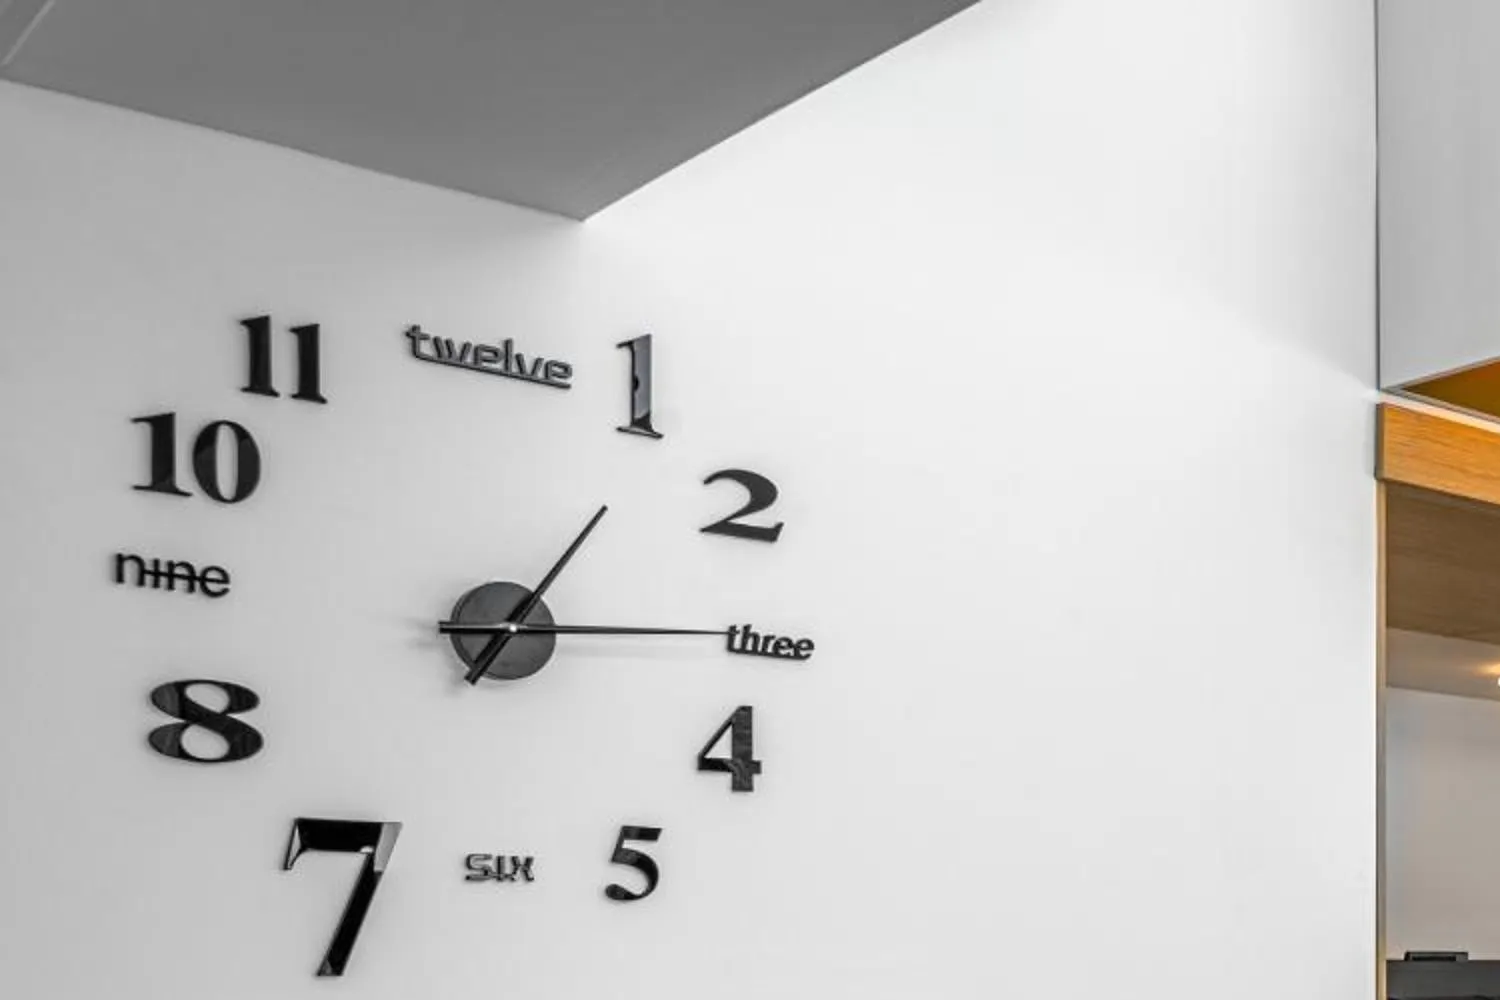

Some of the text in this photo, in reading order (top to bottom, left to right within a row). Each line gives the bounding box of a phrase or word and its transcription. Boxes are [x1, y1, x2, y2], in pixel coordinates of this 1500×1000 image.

[238, 314, 329, 405] 11
[404, 324, 573, 390] twelve
[615, 334, 664, 440] 1
[131, 411, 261, 505] 10
[699, 469, 785, 543] 2
[115, 552, 231, 599] nine
[725, 623, 816, 661] three
[146, 679, 265, 765] 8
[697, 705, 763, 793] 4
[282, 816, 402, 978] 7
[464, 853, 535, 883] six
[604, 825, 663, 902] 5
